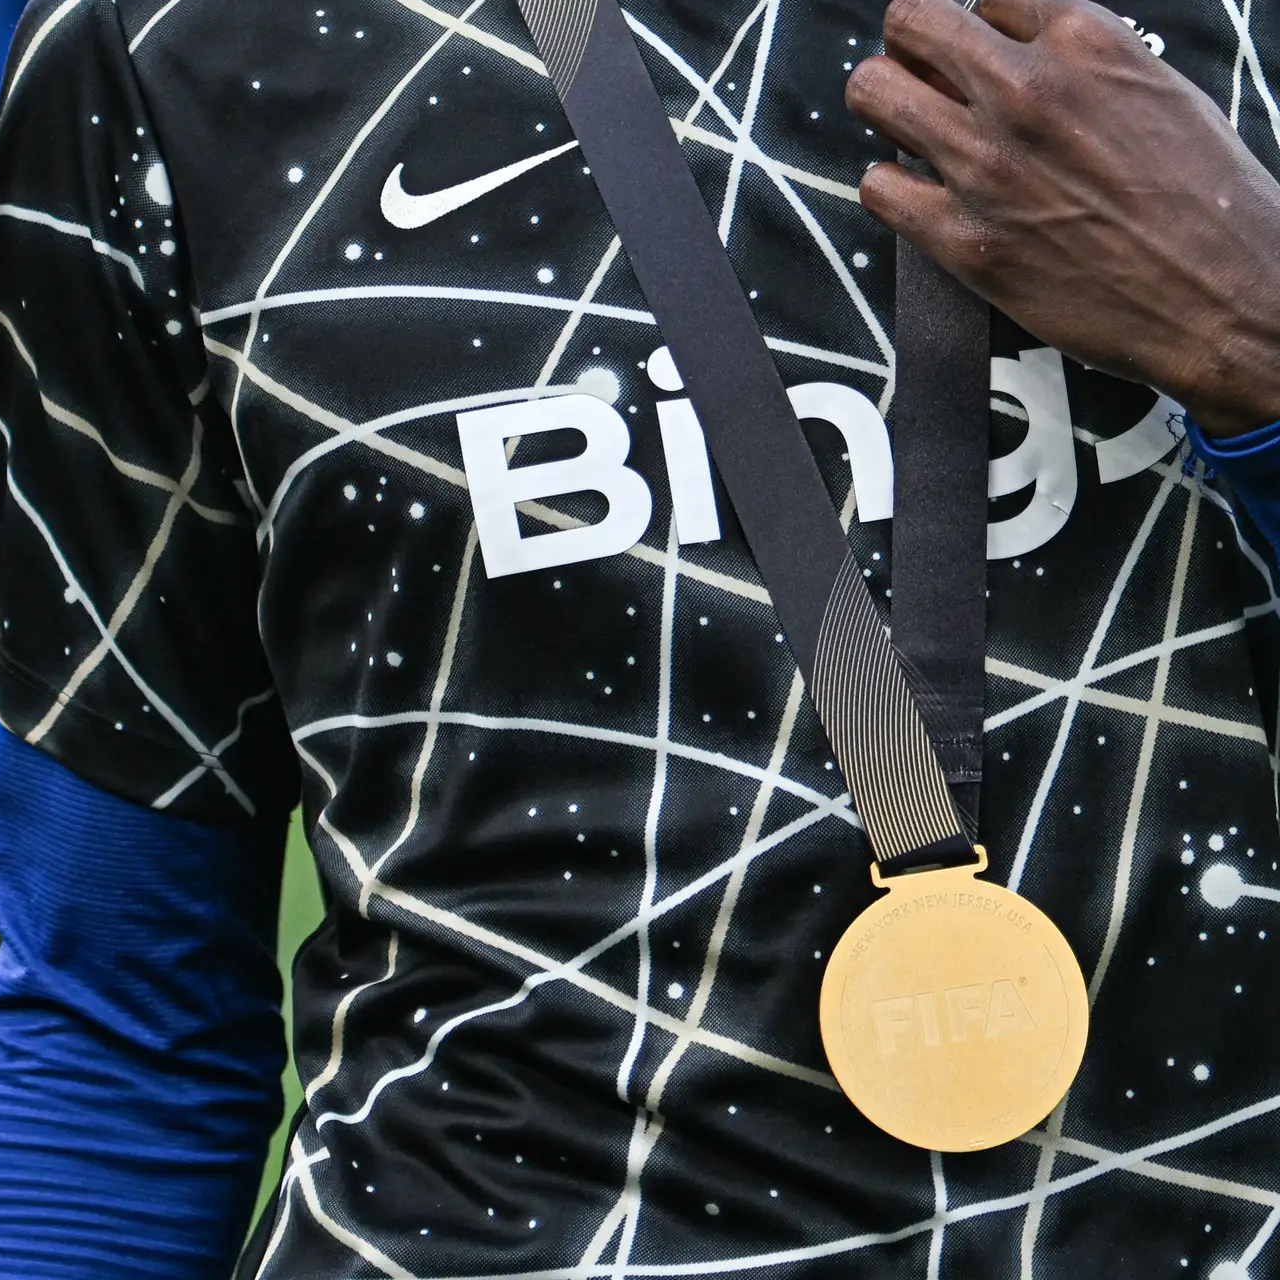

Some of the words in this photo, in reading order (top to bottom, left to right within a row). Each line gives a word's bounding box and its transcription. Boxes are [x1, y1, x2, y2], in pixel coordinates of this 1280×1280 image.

[455, 345, 1188, 579] Bing
[848, 928, 875, 963] NEW
[873, 902, 912, 931] YORK
[913, 892, 948, 911] NEW
[1006, 908, 1032, 935] USA
